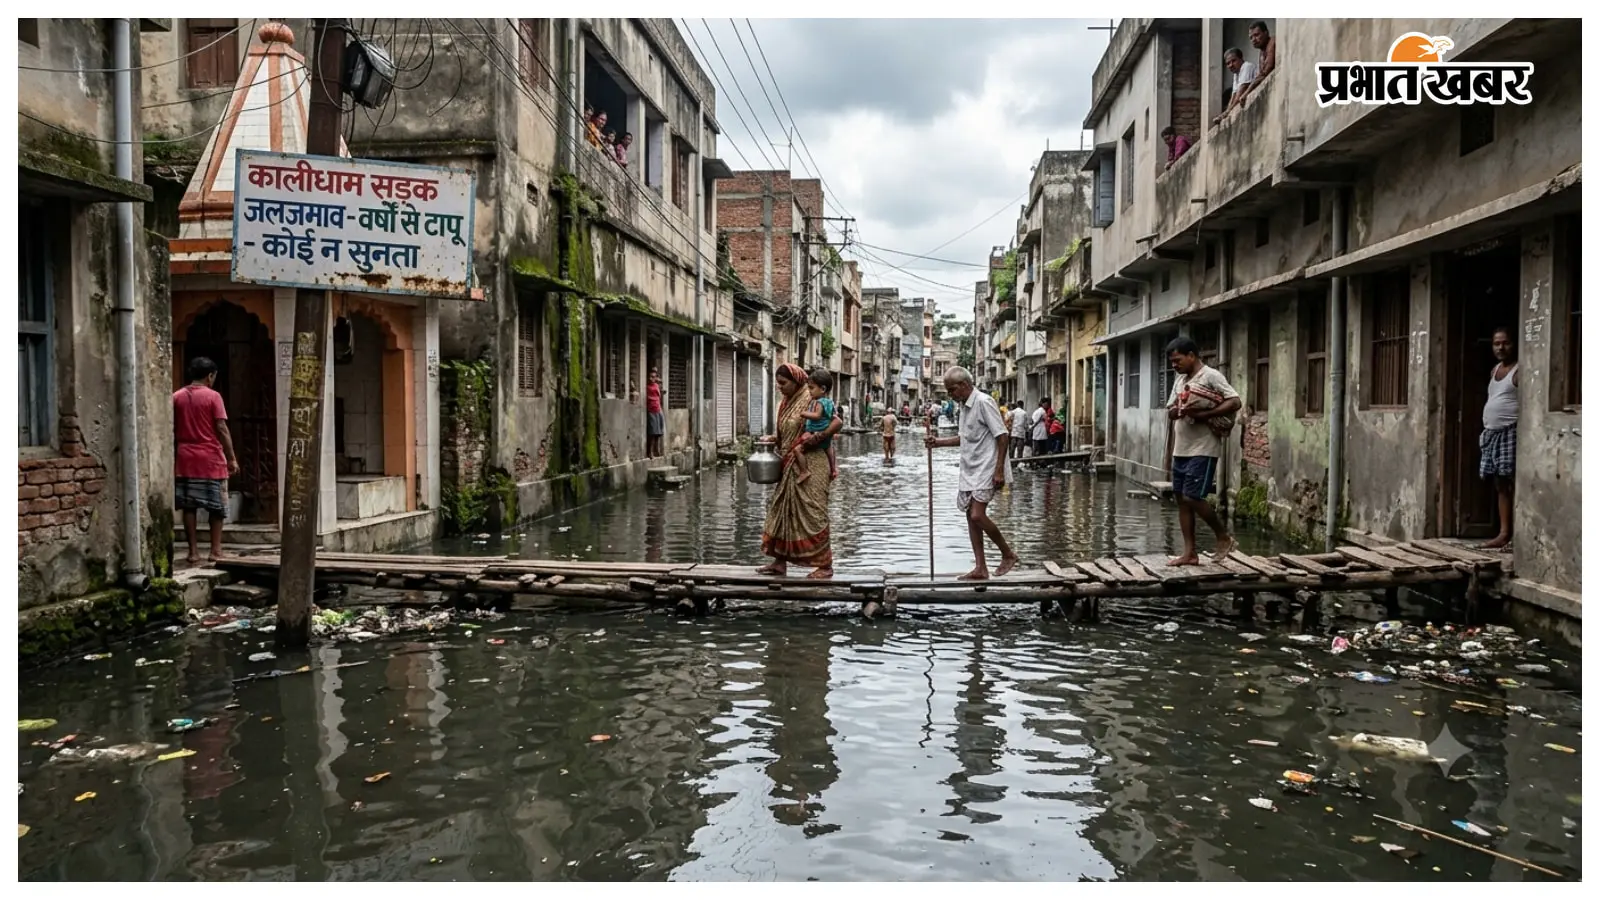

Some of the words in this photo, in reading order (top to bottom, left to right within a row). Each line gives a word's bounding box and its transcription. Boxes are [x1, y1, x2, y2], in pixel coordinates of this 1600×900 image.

[248, 160, 365, 197] कालीधाम
[370, 174, 439, 206] सड़क
[401, 203, 420, 236] से
[424, 212, 466, 247] टापू
[262, 227, 315, 265] कोई
[321, 238, 342, 262] न
[348, 240, 421, 273] सुनता
